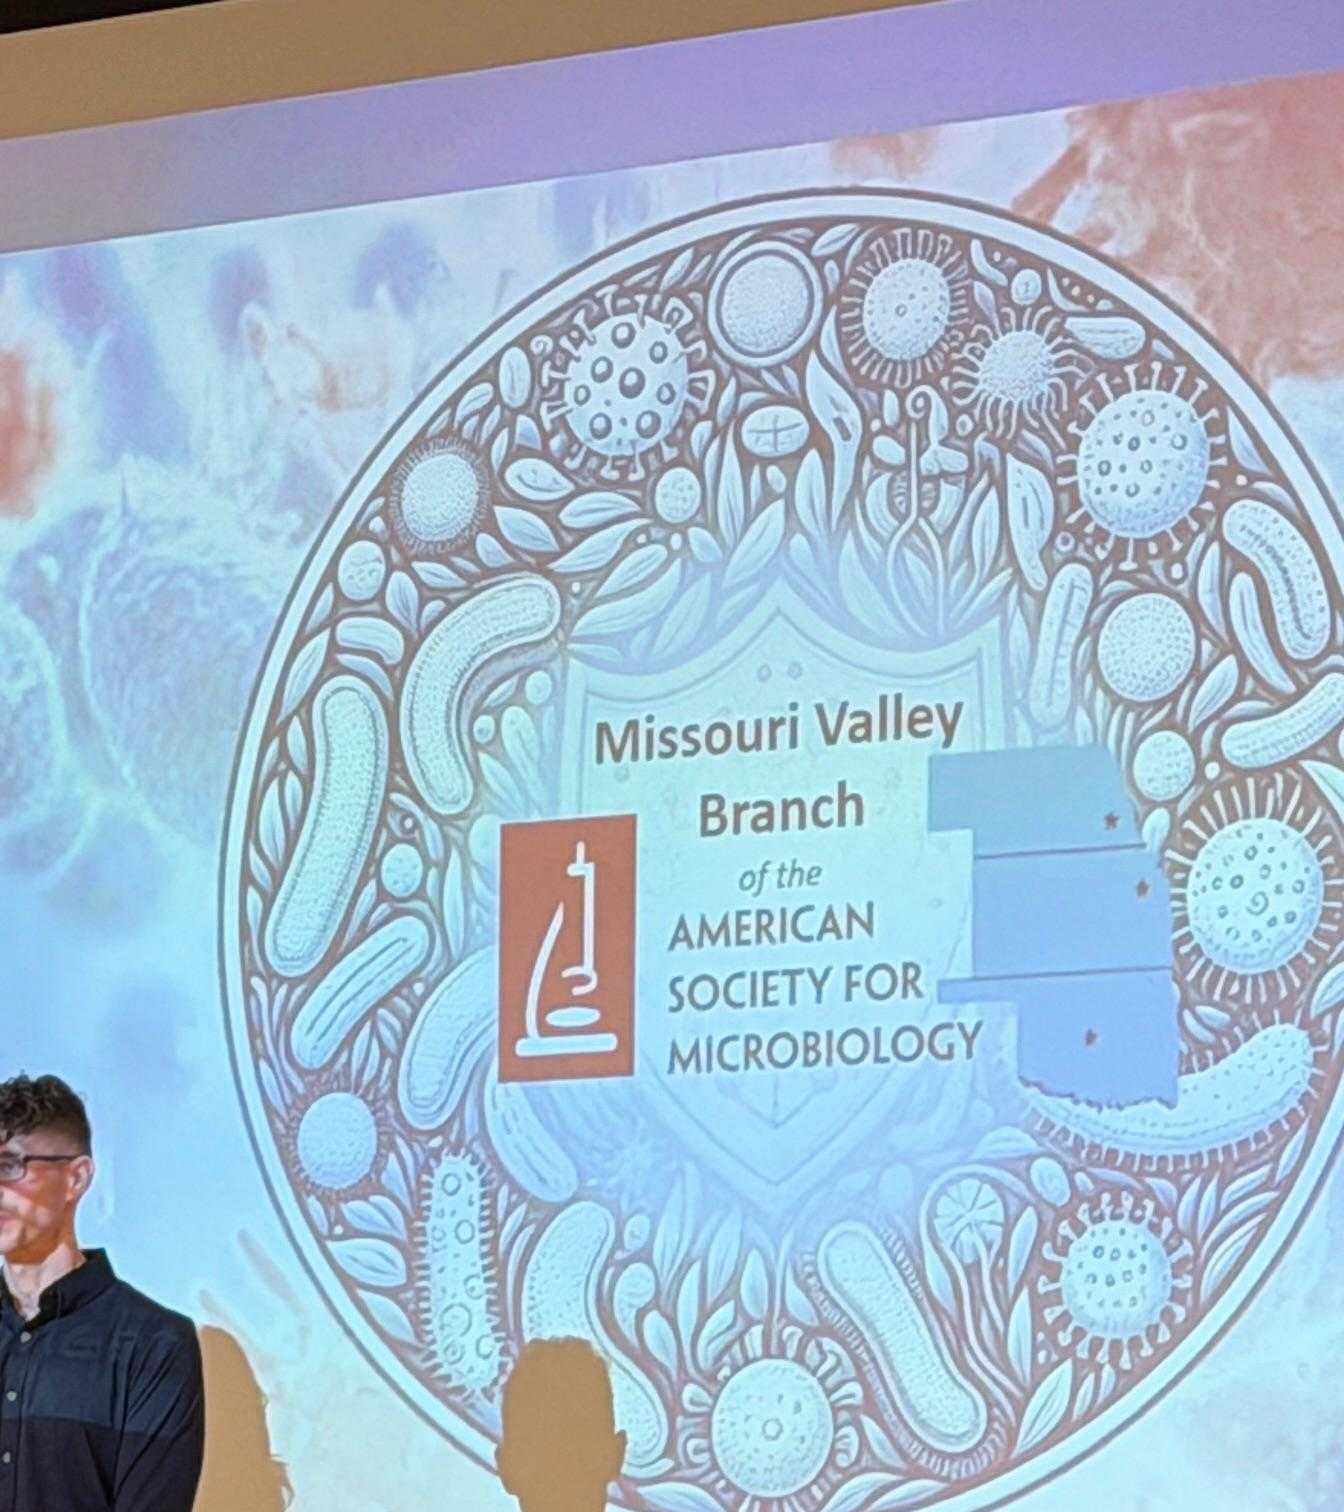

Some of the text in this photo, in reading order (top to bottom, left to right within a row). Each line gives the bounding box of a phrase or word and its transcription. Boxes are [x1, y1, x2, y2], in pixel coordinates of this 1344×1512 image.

[595, 692, 965, 764] Missouri Valley
[699, 780, 864, 838] Branch
[738, 858, 823, 898] of the
[667, 901, 875, 952] AMERICAN
[668, 961, 924, 1013] SOCIETY FOR
[667, 1019, 985, 1075] MICROBIOLOGY
